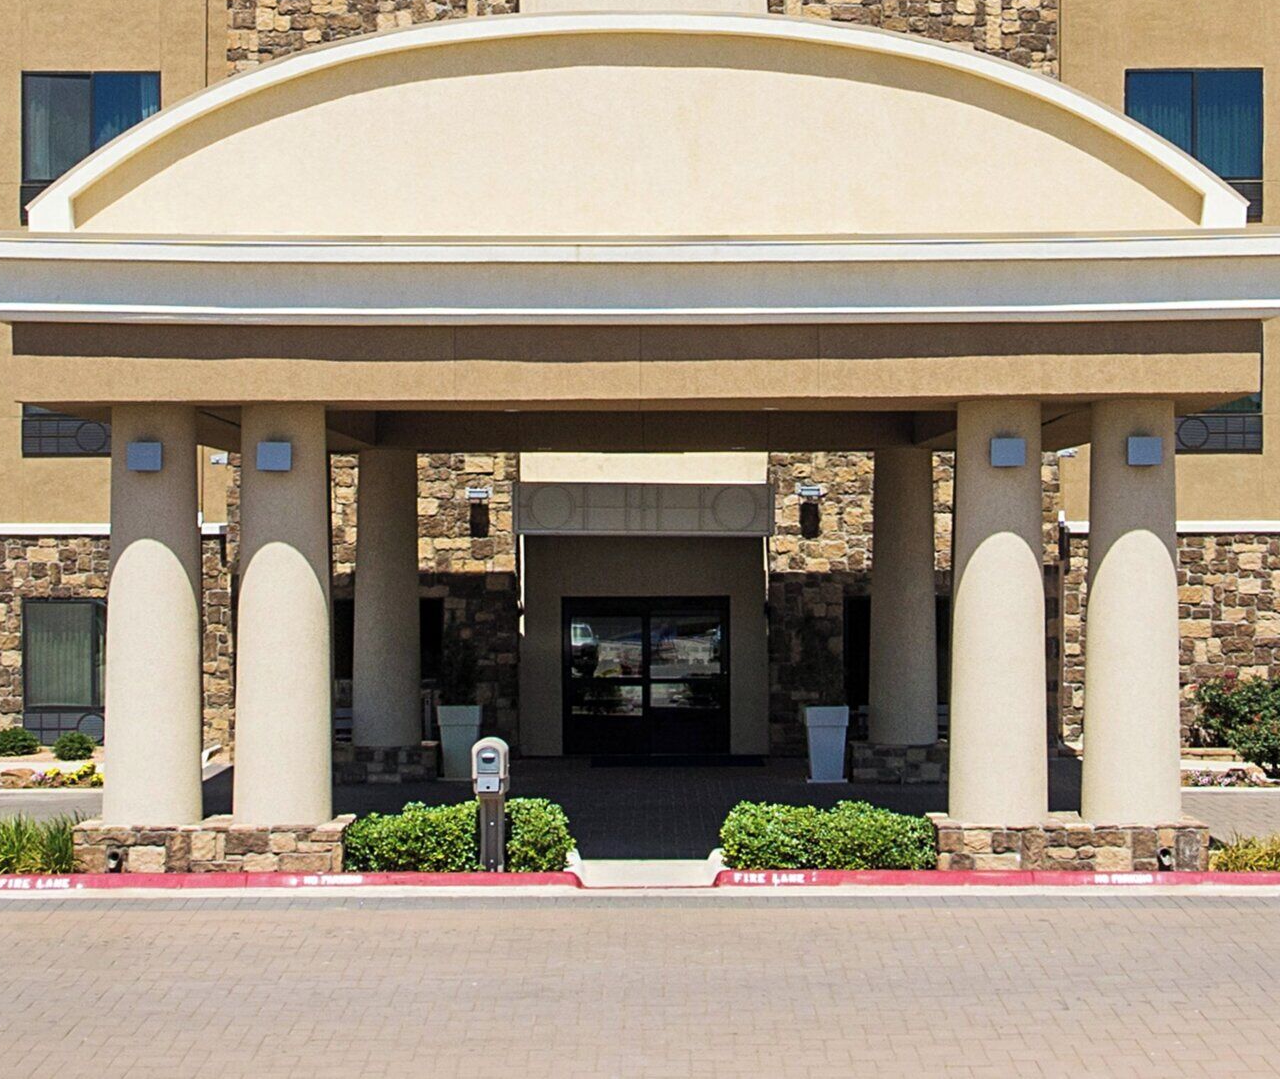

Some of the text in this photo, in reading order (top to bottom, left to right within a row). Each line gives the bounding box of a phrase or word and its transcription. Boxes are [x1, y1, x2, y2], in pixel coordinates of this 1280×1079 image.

[35, 878, 70, 889] LANE
[733, 872, 805, 884] FIRE LANE
